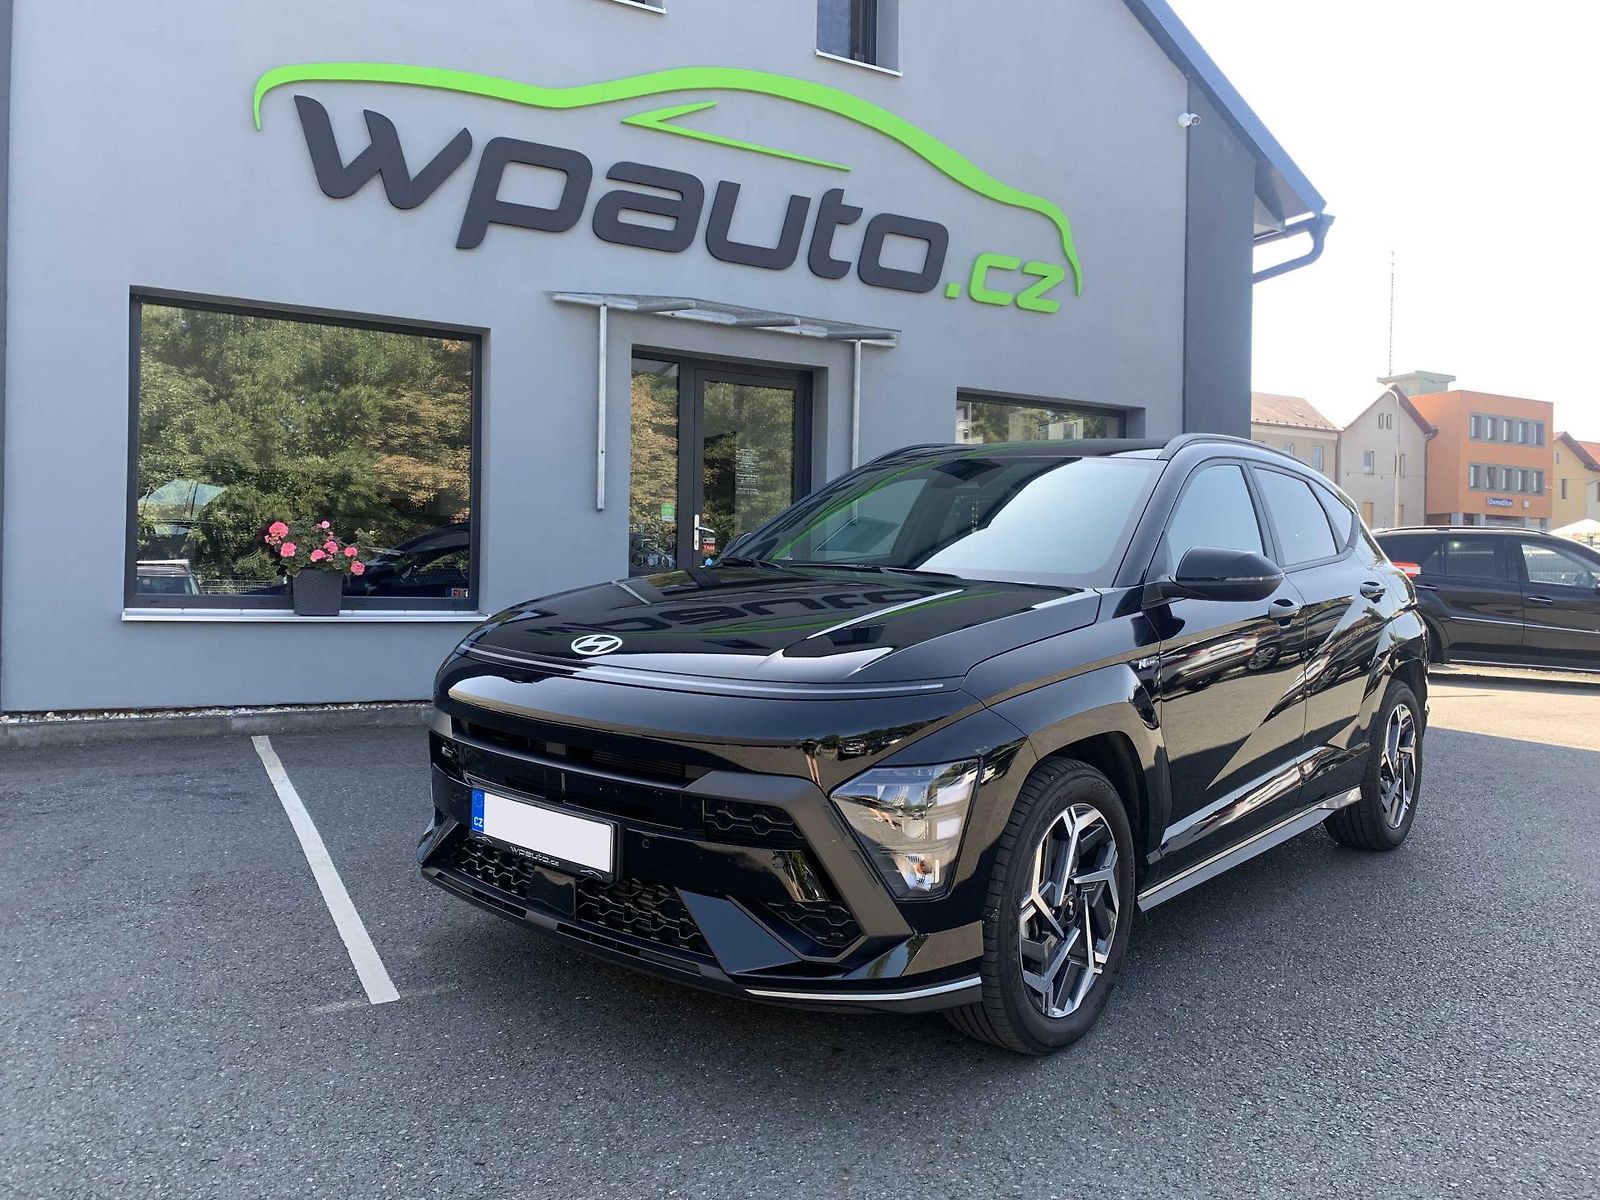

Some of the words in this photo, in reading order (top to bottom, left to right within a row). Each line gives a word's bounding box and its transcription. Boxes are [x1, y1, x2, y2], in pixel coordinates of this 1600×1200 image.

[294, 95, 1065, 313] wpauto.cz
[473, 816, 483, 827] CZ
[510, 846, 560, 867] wpauto.cz
